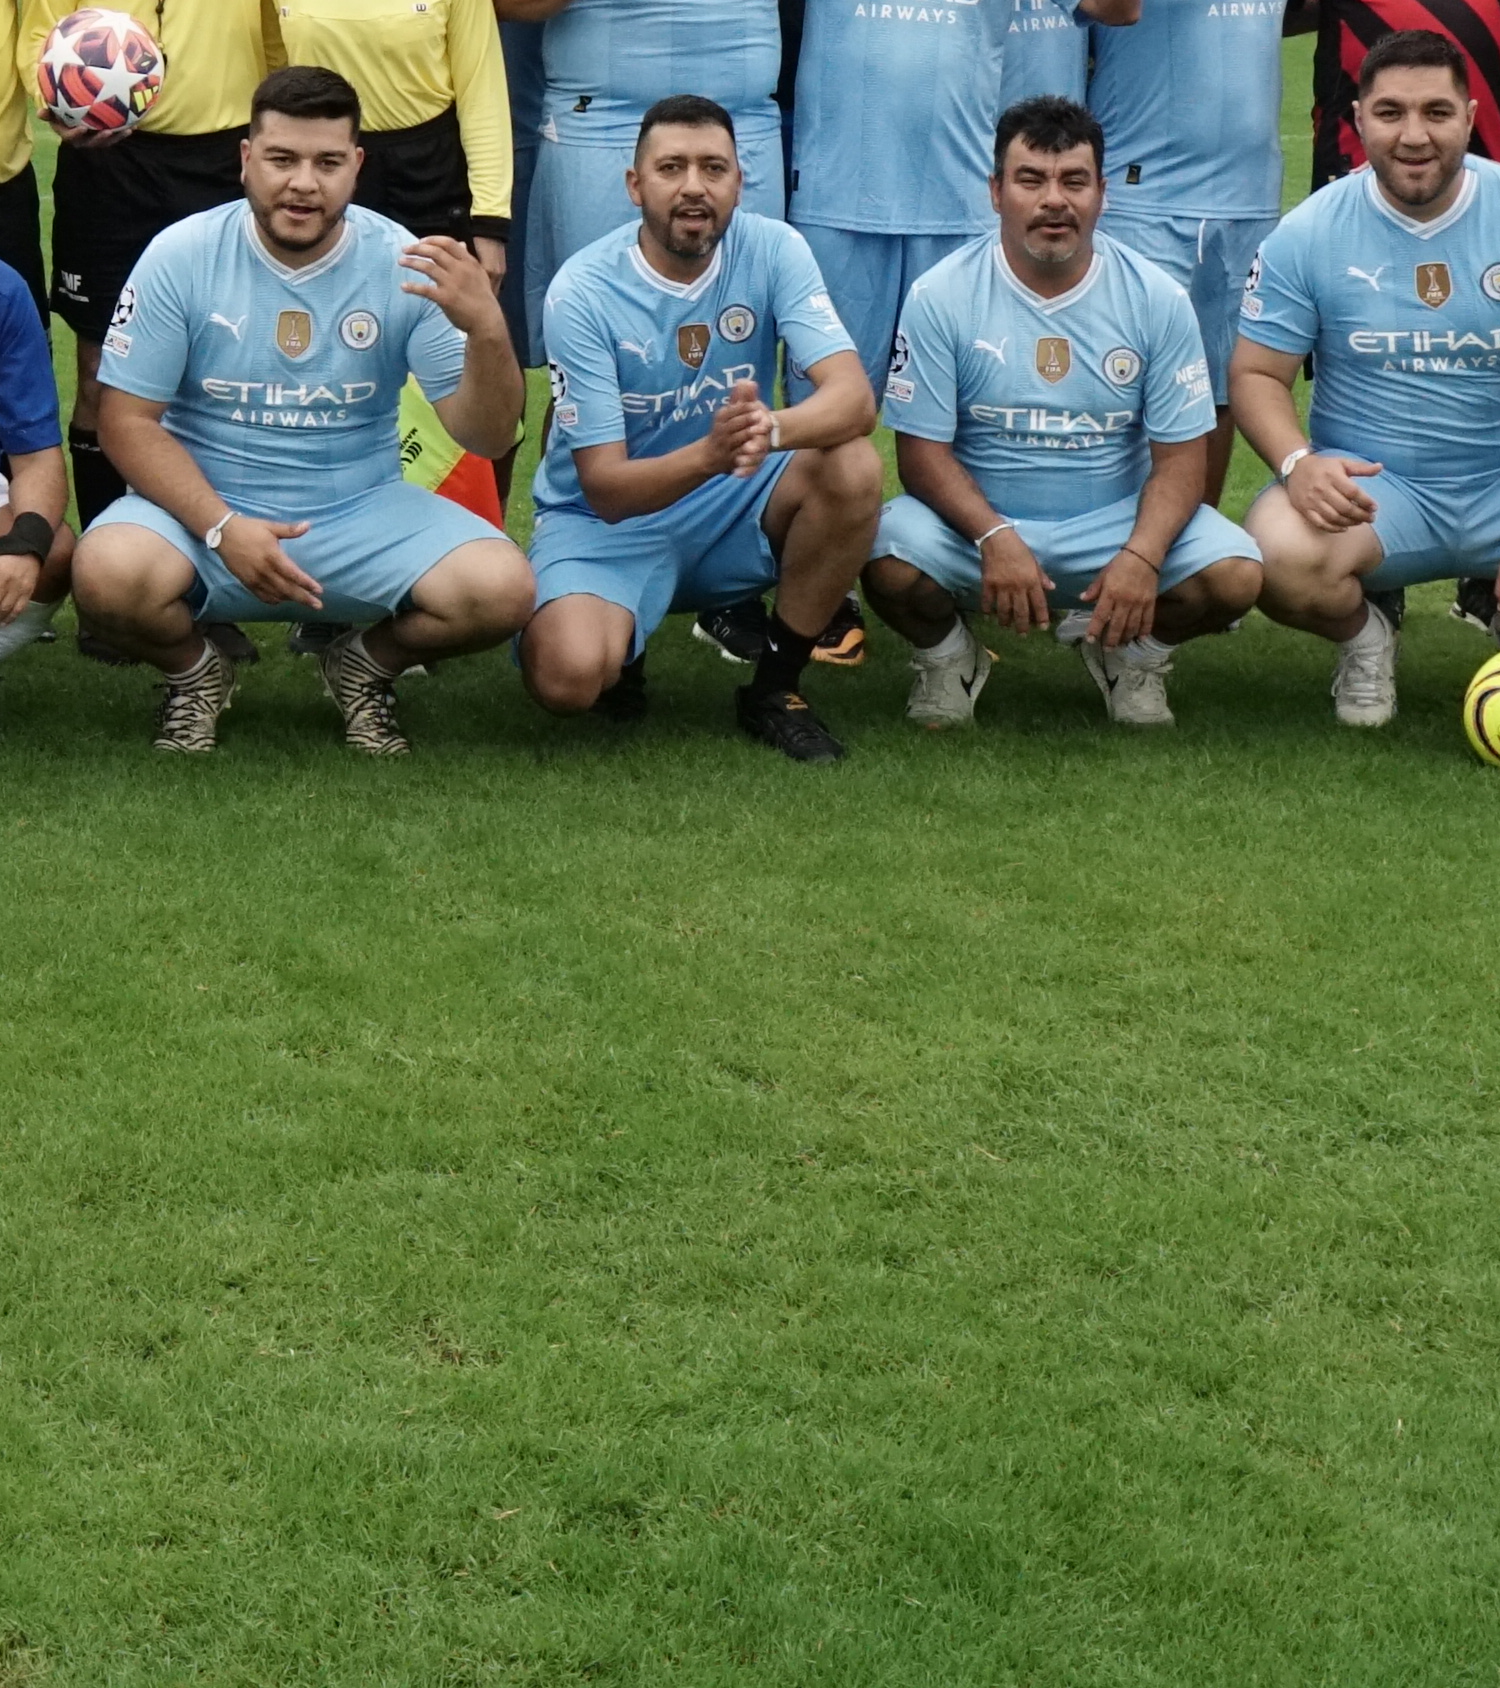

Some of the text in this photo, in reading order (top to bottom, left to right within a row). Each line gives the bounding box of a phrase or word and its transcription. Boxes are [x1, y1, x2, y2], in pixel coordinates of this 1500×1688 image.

[854, 3, 957, 24] AIRWAYS
[1383, 355, 1498, 372] AIRWAYS
[201, 377, 377, 406] ETIHAD
[231, 408, 346, 427] AIRWAYS
[969, 404, 1133, 432] ETIHAD
[997, 433, 1104, 450] AIRWAYS
